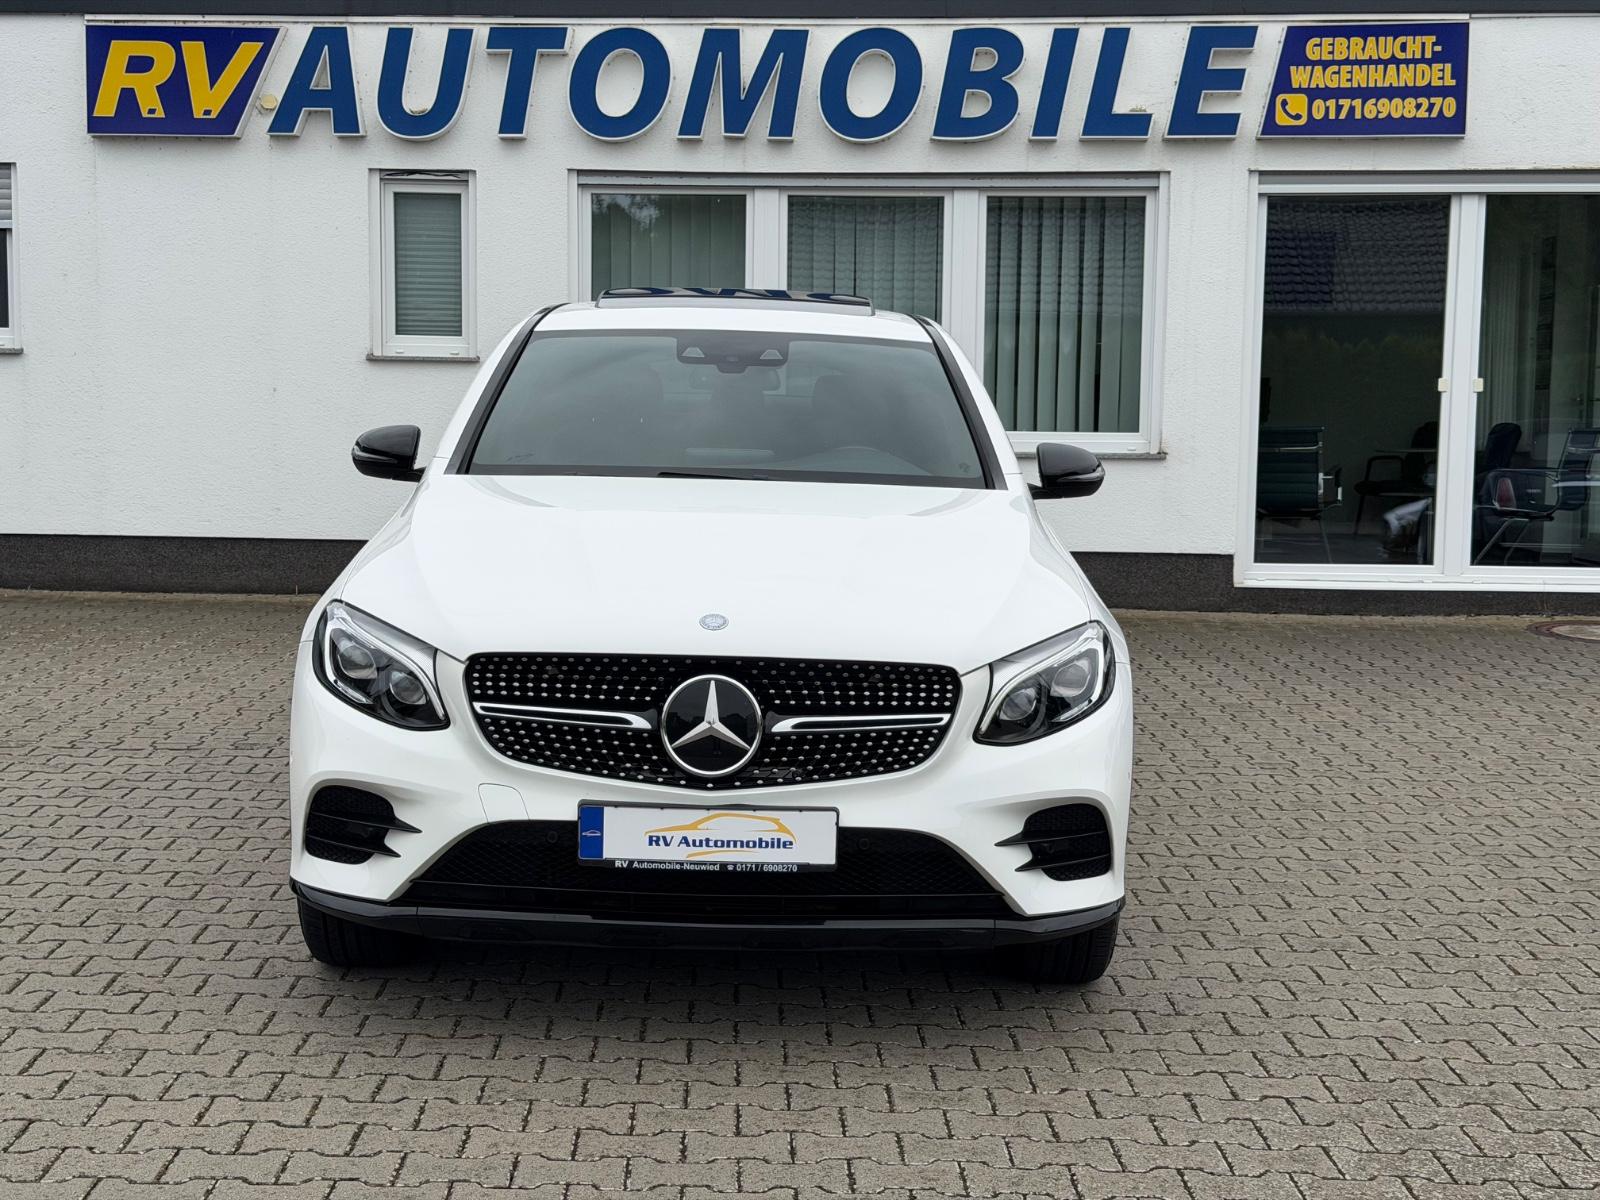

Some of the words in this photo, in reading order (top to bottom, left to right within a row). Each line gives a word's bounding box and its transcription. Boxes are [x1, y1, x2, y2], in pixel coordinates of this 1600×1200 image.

[1305, 35, 1442, 61] GEBRAUCHT-
[266, 25, 1258, 142] AUTOMOBILE
[1290, 63, 1456, 89] WAGENHANDEL
[1312, 97, 1457, 120] 01716908270
[648, 835, 674, 848] RV
[677, 835, 794, 850] Automobile
[614, 860, 629, 868] RV
[632, 860, 720, 871] Automobile-Neuwied
[736, 863, 756, 872] 0171
[763, 864, 798, 872] 6908270
